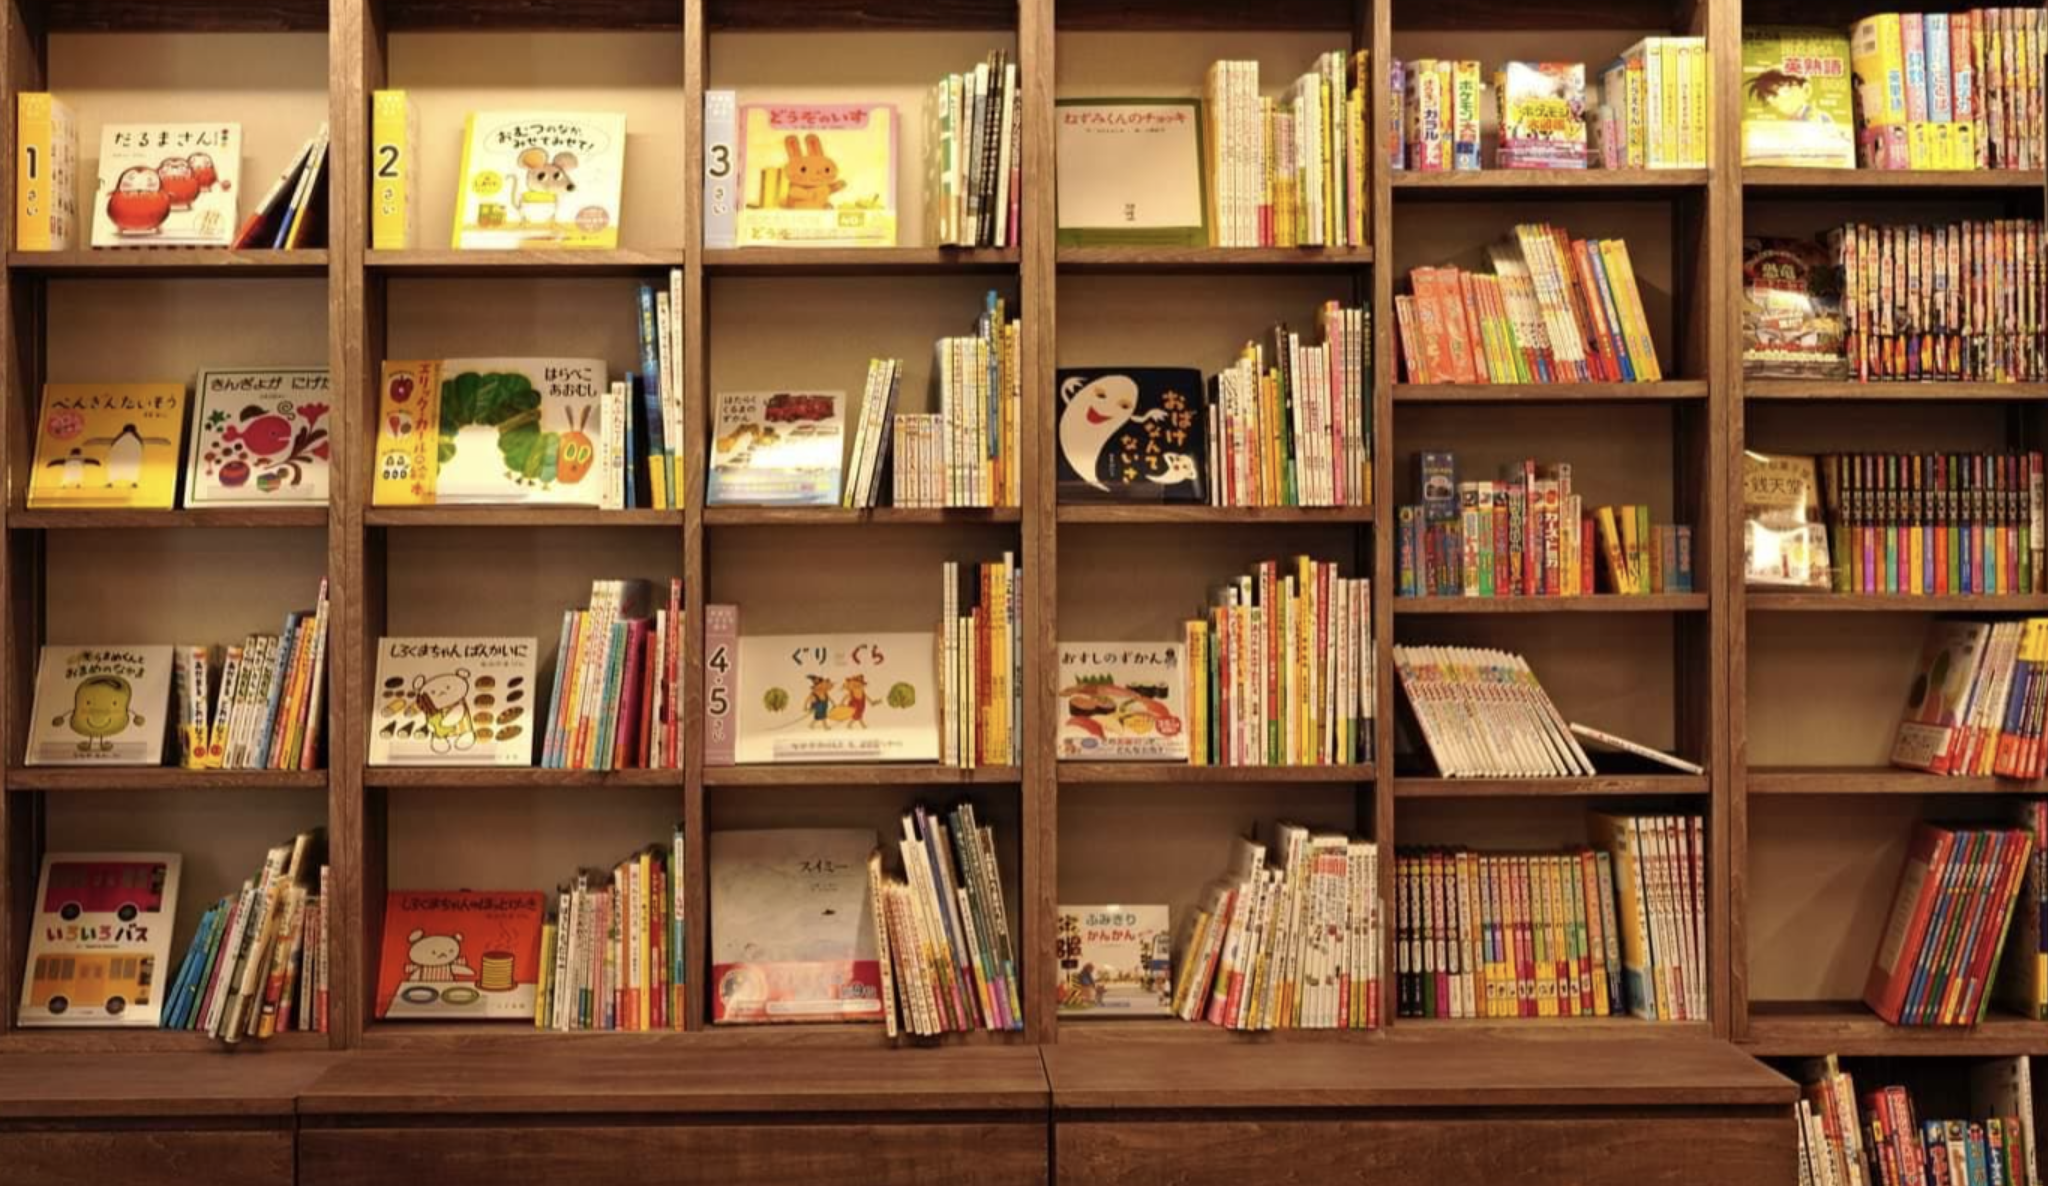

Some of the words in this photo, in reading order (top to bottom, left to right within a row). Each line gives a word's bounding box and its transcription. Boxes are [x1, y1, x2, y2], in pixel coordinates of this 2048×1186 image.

[769, 109, 868, 126] どうぞのいす
[1063, 111, 1189, 125] ねずみくんのチョッキ
[210, 376, 283, 392] きんぎょが
[549, 383, 597, 398] あおむし
[51, 395, 178, 410] ぺんぎんたいそう
[1163, 389, 1192, 447] おばけ
[1144, 422, 1162, 470] なんて
[390, 644, 462, 658] しろくまちゃん
[1061, 649, 1160, 666] おすしのずかん
[799, 859, 850, 874] スイミー
[1084, 913, 1137, 926] ふみきり
[46, 922, 149, 943] いろいろバス
[1085, 929, 1137, 943] かんかん
